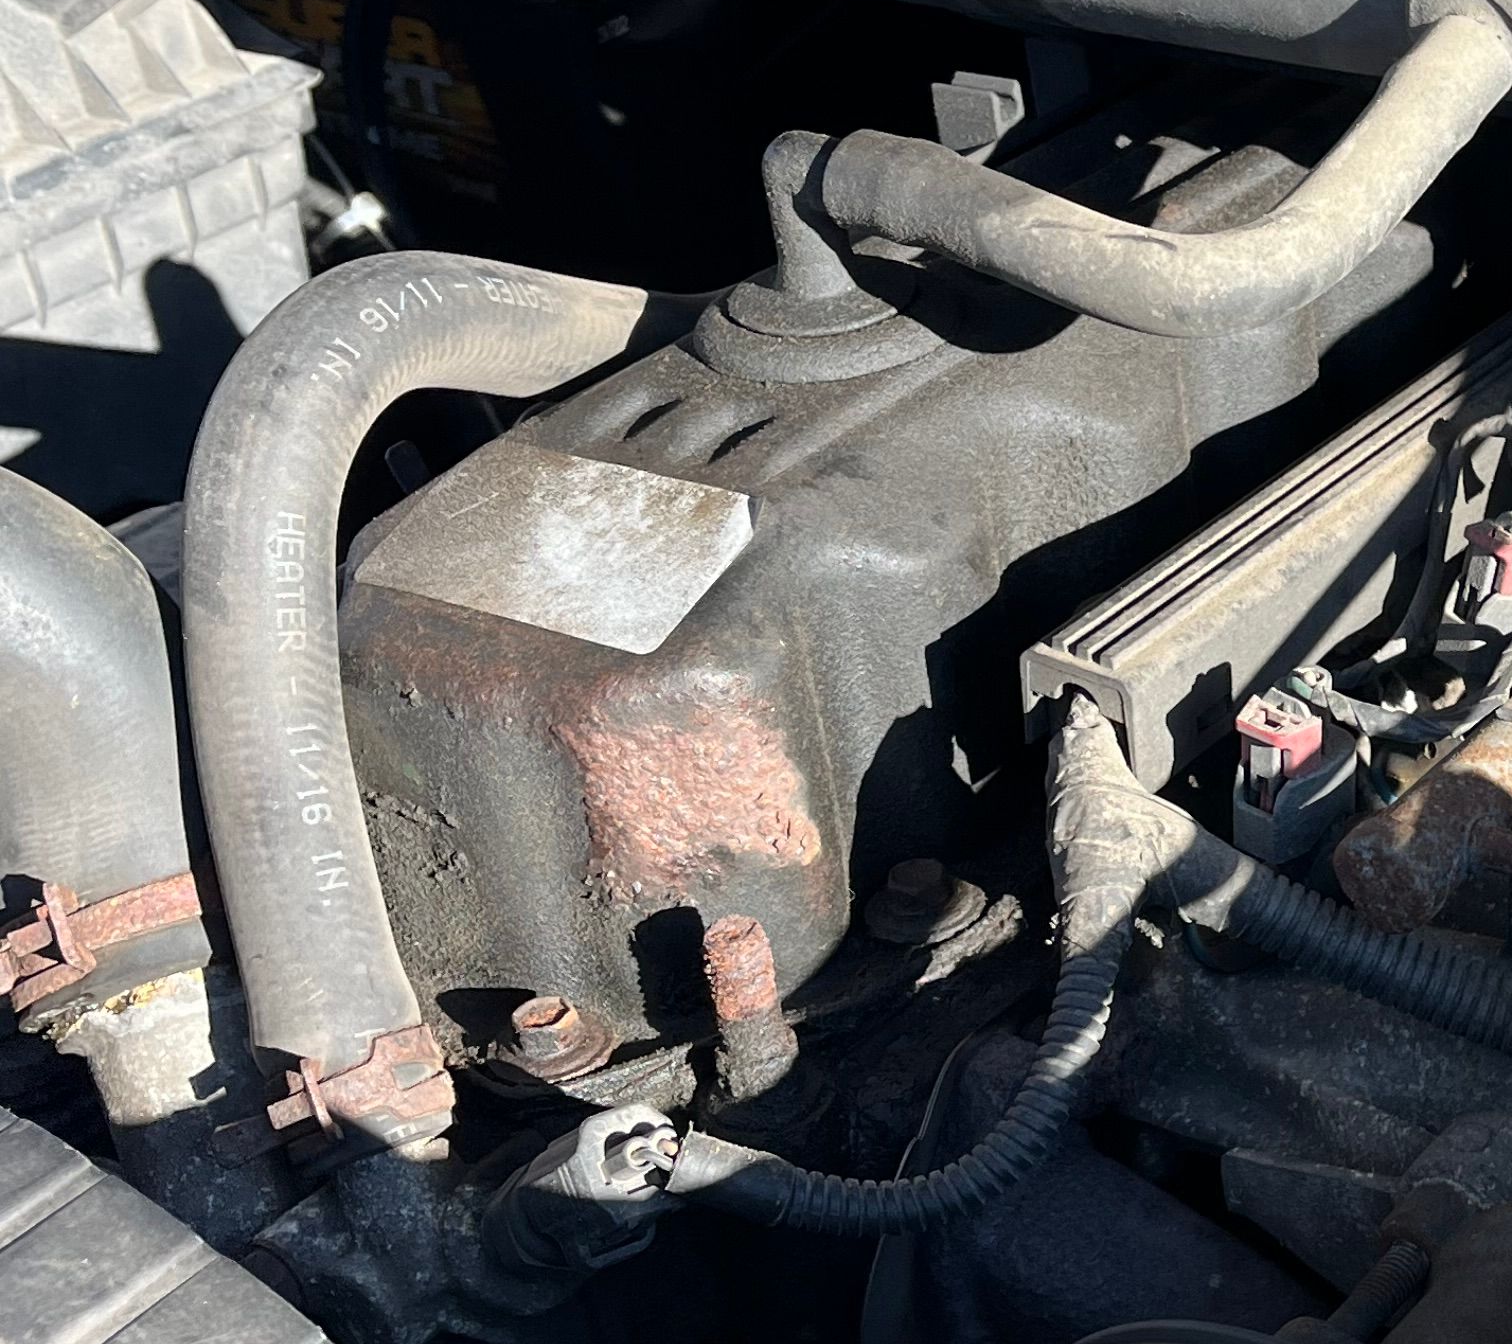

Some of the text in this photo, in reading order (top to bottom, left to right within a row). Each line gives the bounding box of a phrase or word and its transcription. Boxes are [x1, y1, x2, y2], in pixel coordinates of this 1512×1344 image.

[359, 277, 443, 333] 11/16
[274, 510, 307, 653] HEATER
[285, 722, 333, 826] 11/16
